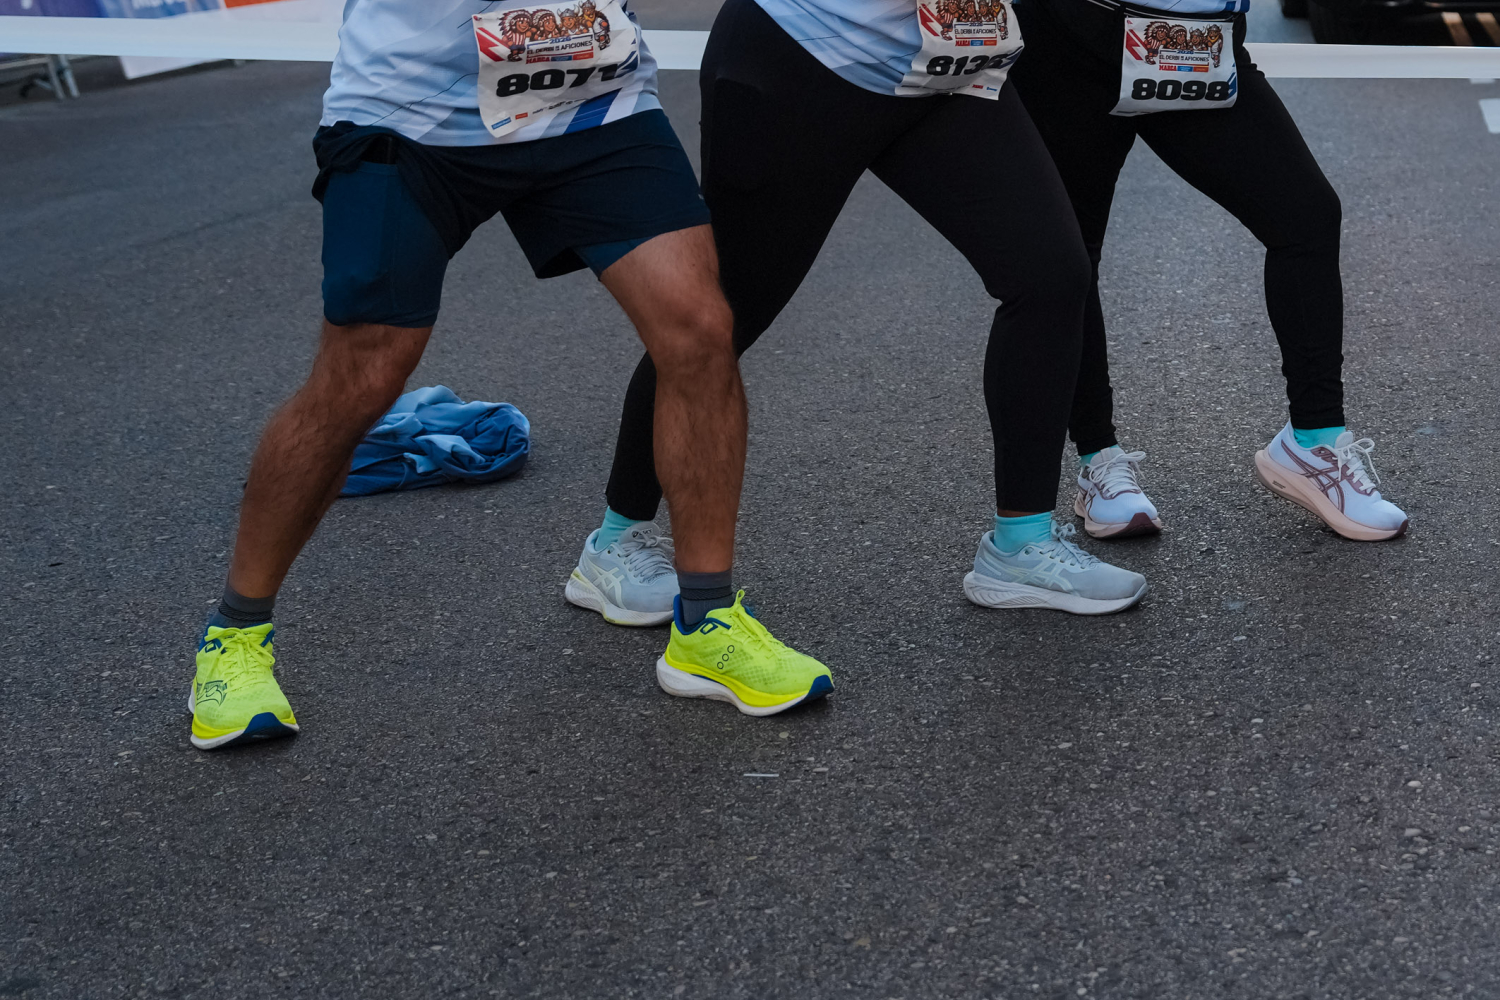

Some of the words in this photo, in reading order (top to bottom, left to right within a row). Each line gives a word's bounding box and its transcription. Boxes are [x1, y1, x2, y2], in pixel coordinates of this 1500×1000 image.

[561, 40, 593, 51] AFICIONES
[496, 63, 618, 97] 8071
[1131, 78, 1230, 101] 8098
